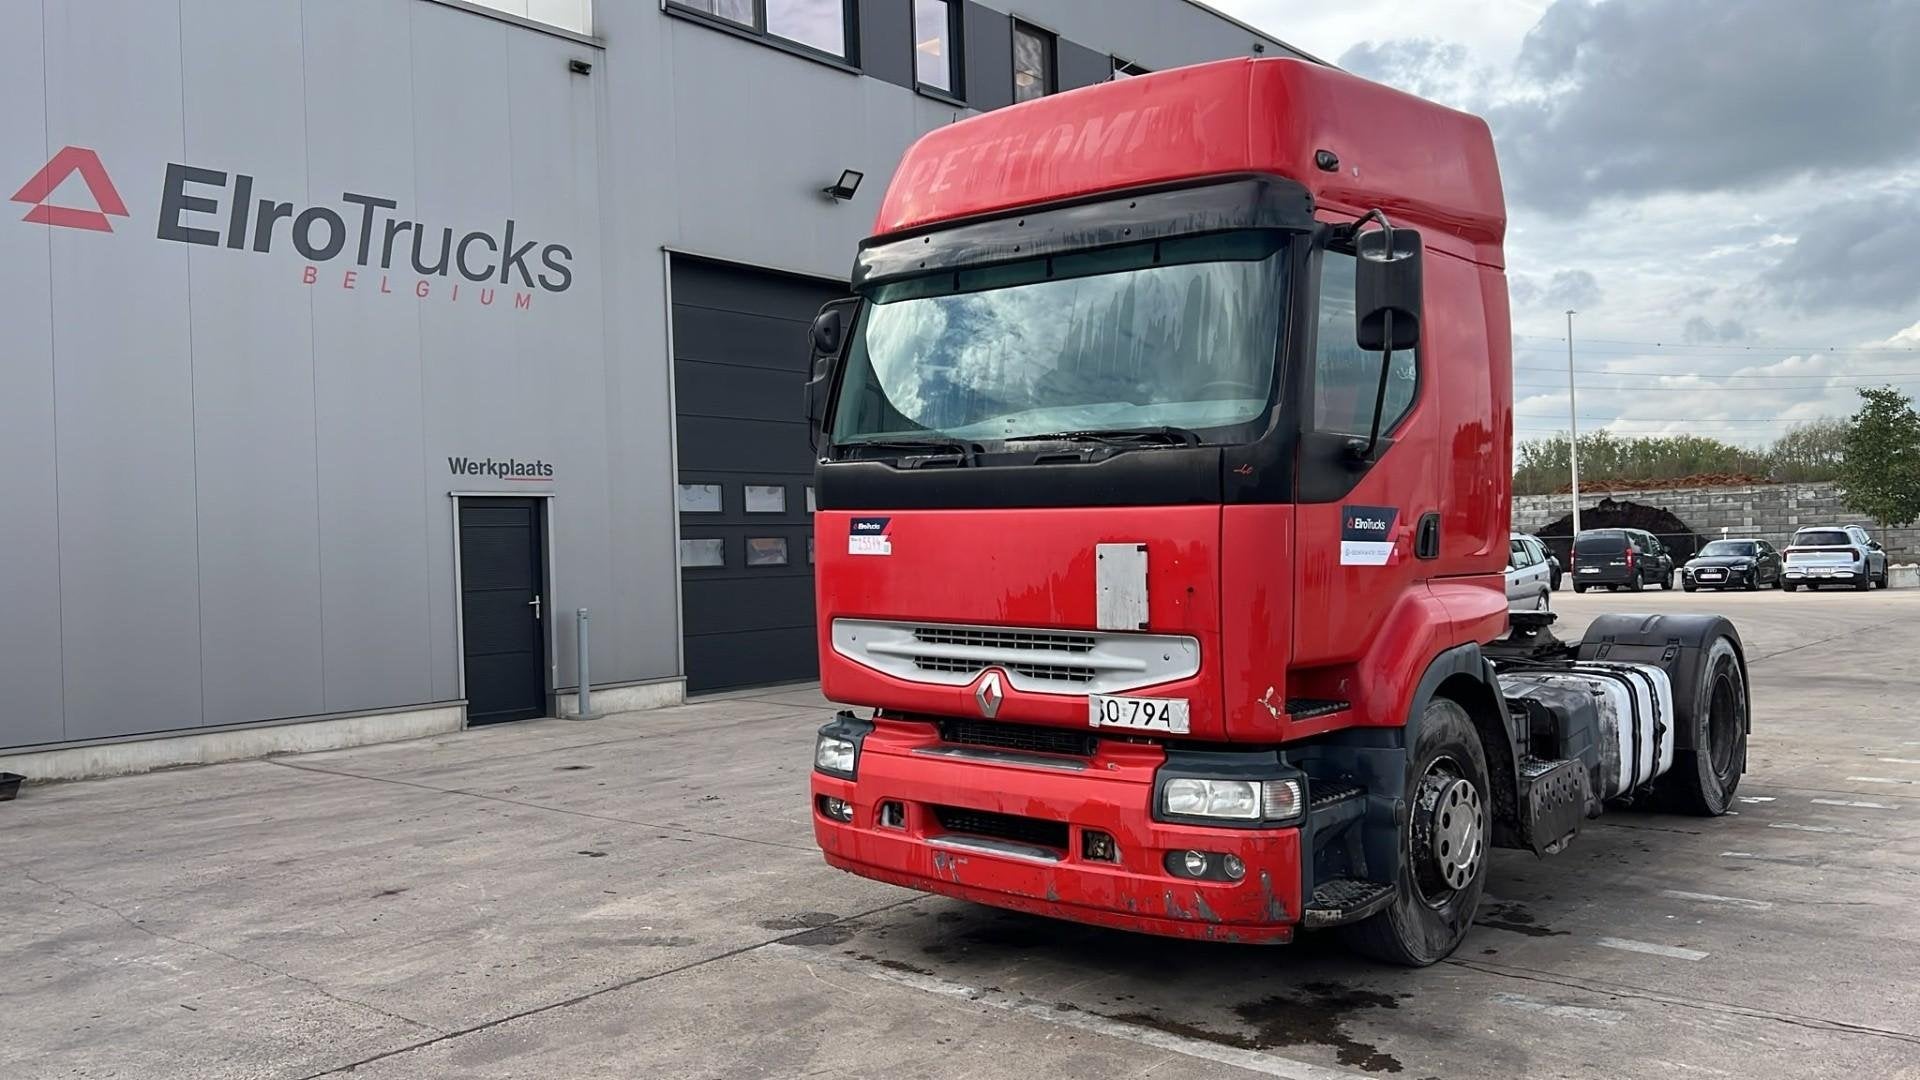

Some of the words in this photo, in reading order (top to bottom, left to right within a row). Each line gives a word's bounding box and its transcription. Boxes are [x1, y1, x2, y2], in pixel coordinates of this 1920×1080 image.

[157, 162, 574, 292] ElroTrucks
[303, 265, 532, 310] BELGIUM
[448, 457, 553, 479] Werkplaats
[1354, 518, 1386, 530] ElroTrucks
